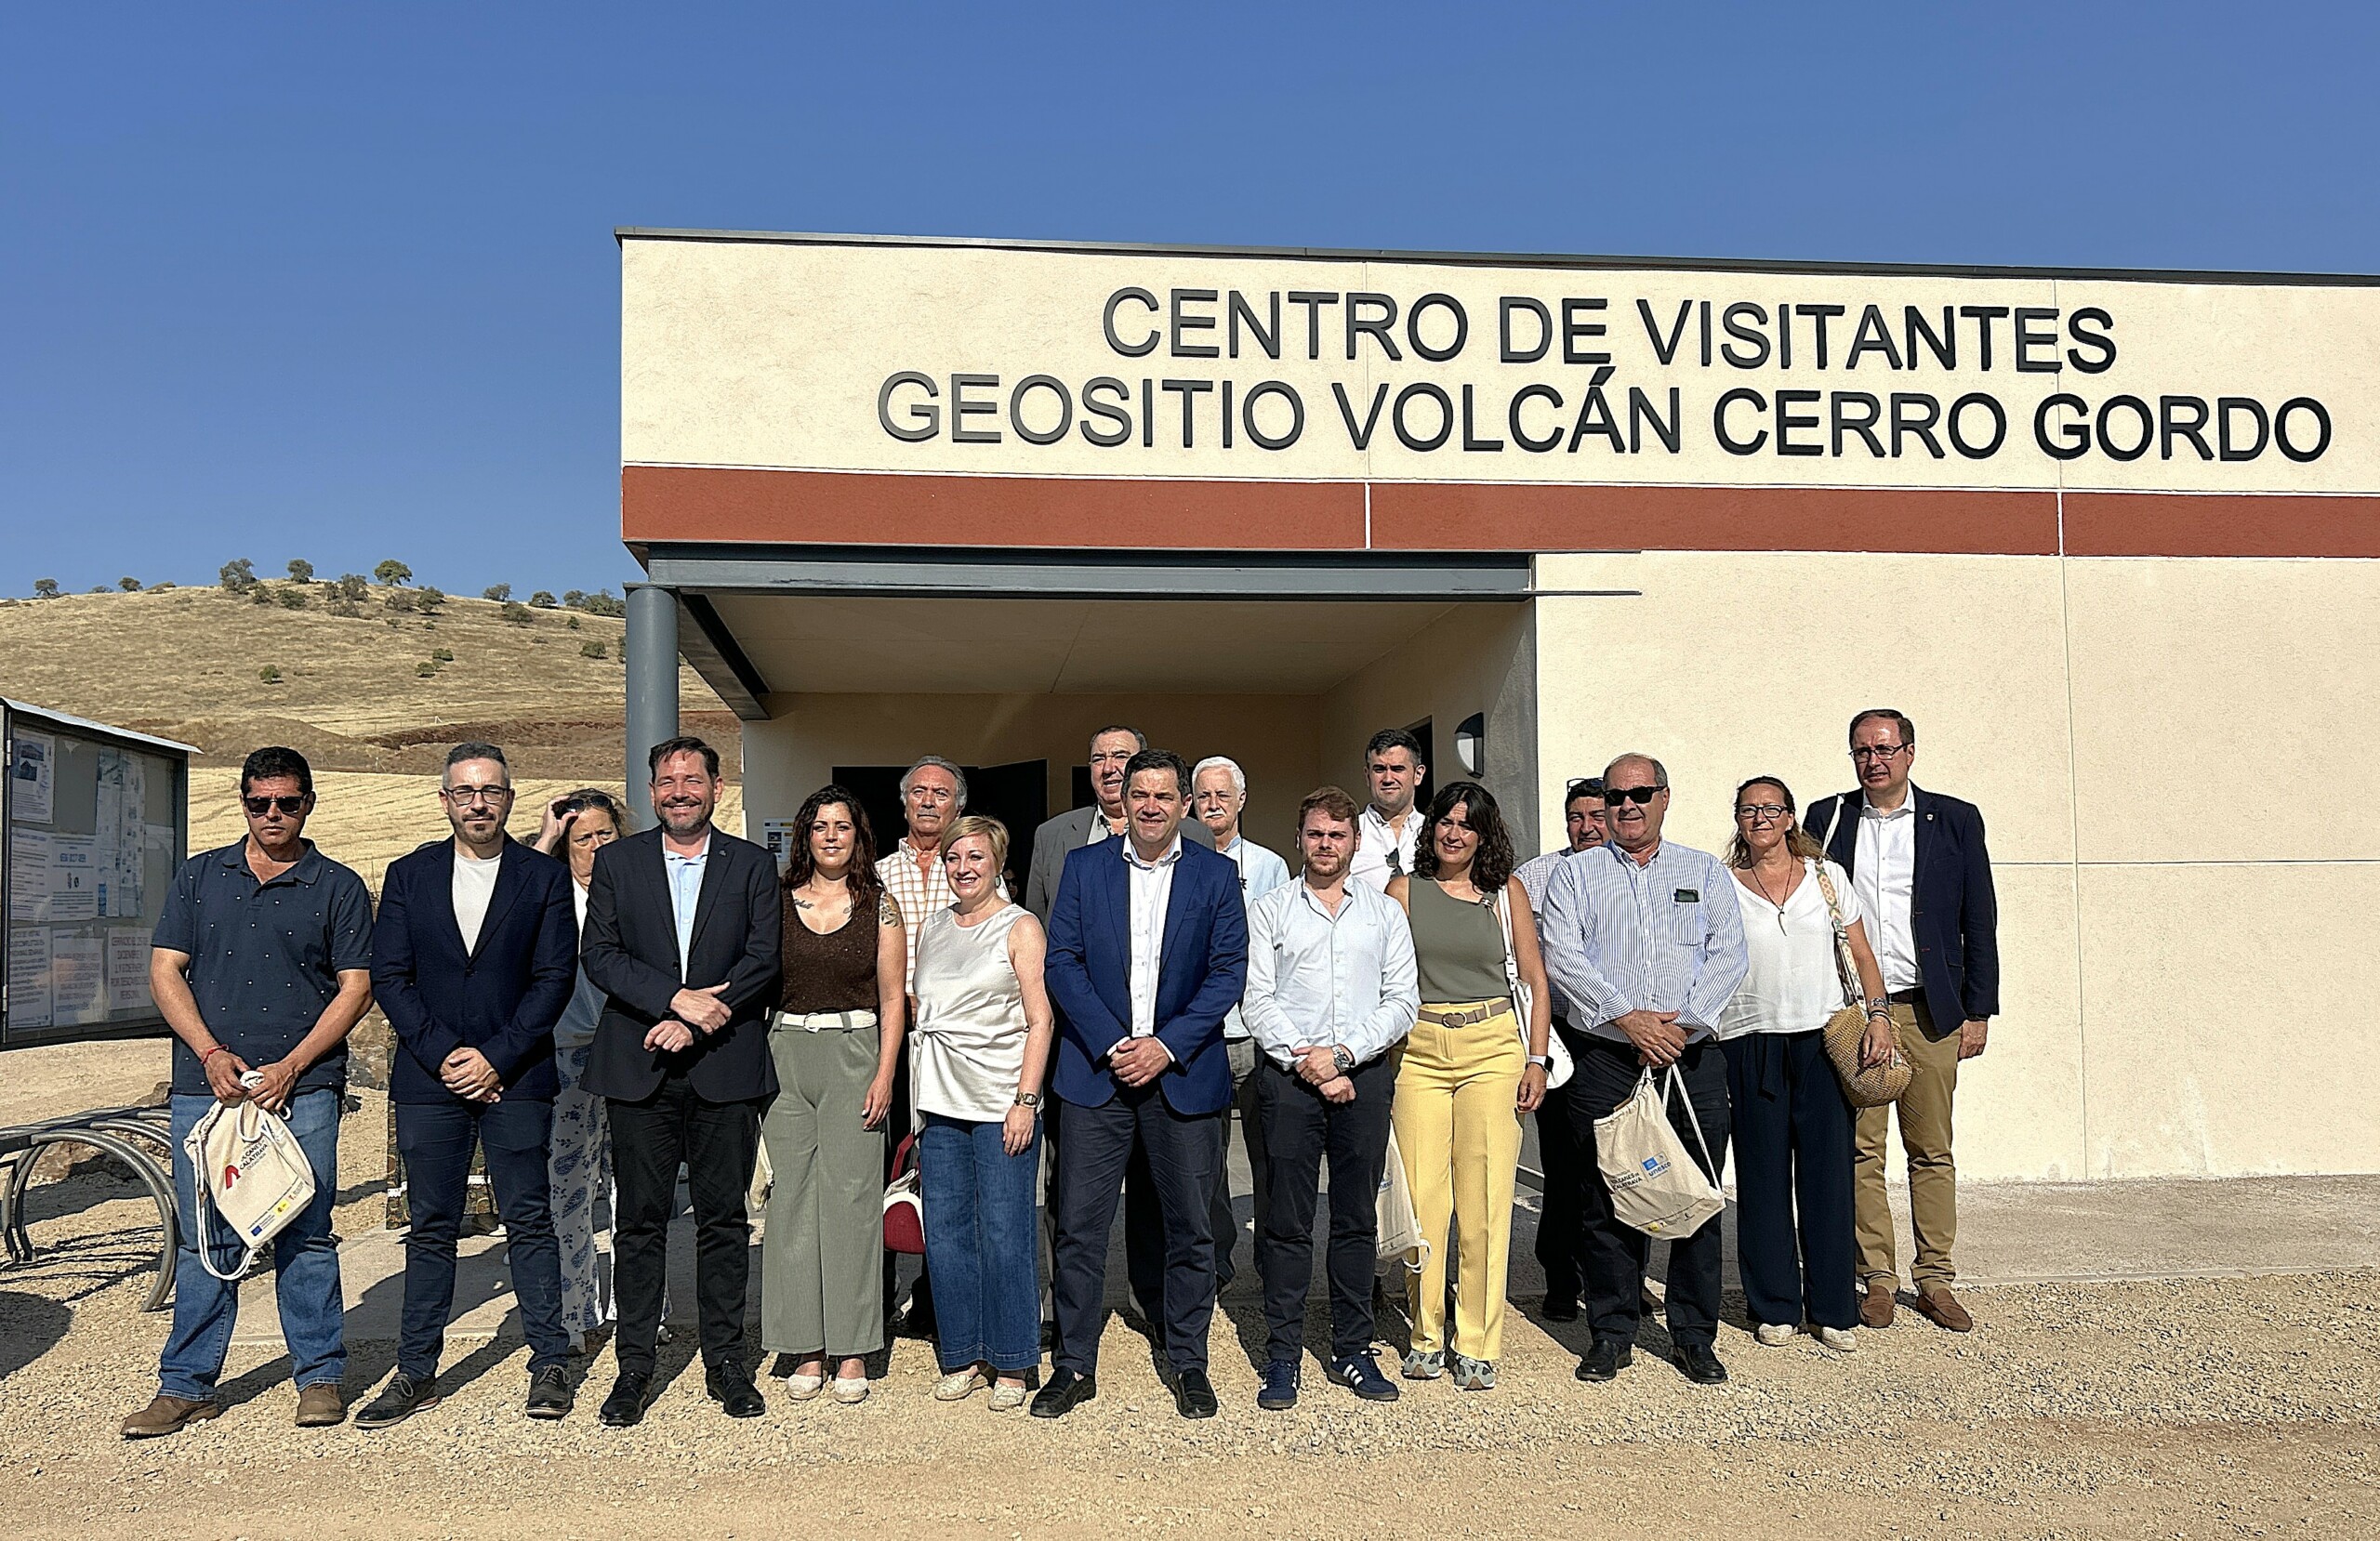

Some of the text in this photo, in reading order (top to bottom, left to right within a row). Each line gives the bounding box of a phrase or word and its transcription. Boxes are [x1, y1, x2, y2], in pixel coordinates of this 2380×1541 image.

[1103, 286, 2118, 375] CENTRO DE VISITANTES
[878, 365, 2332, 463] GEOSITIO VOLCÁN CERRO GORDO
[1648, 1162, 1672, 1177] unesco
